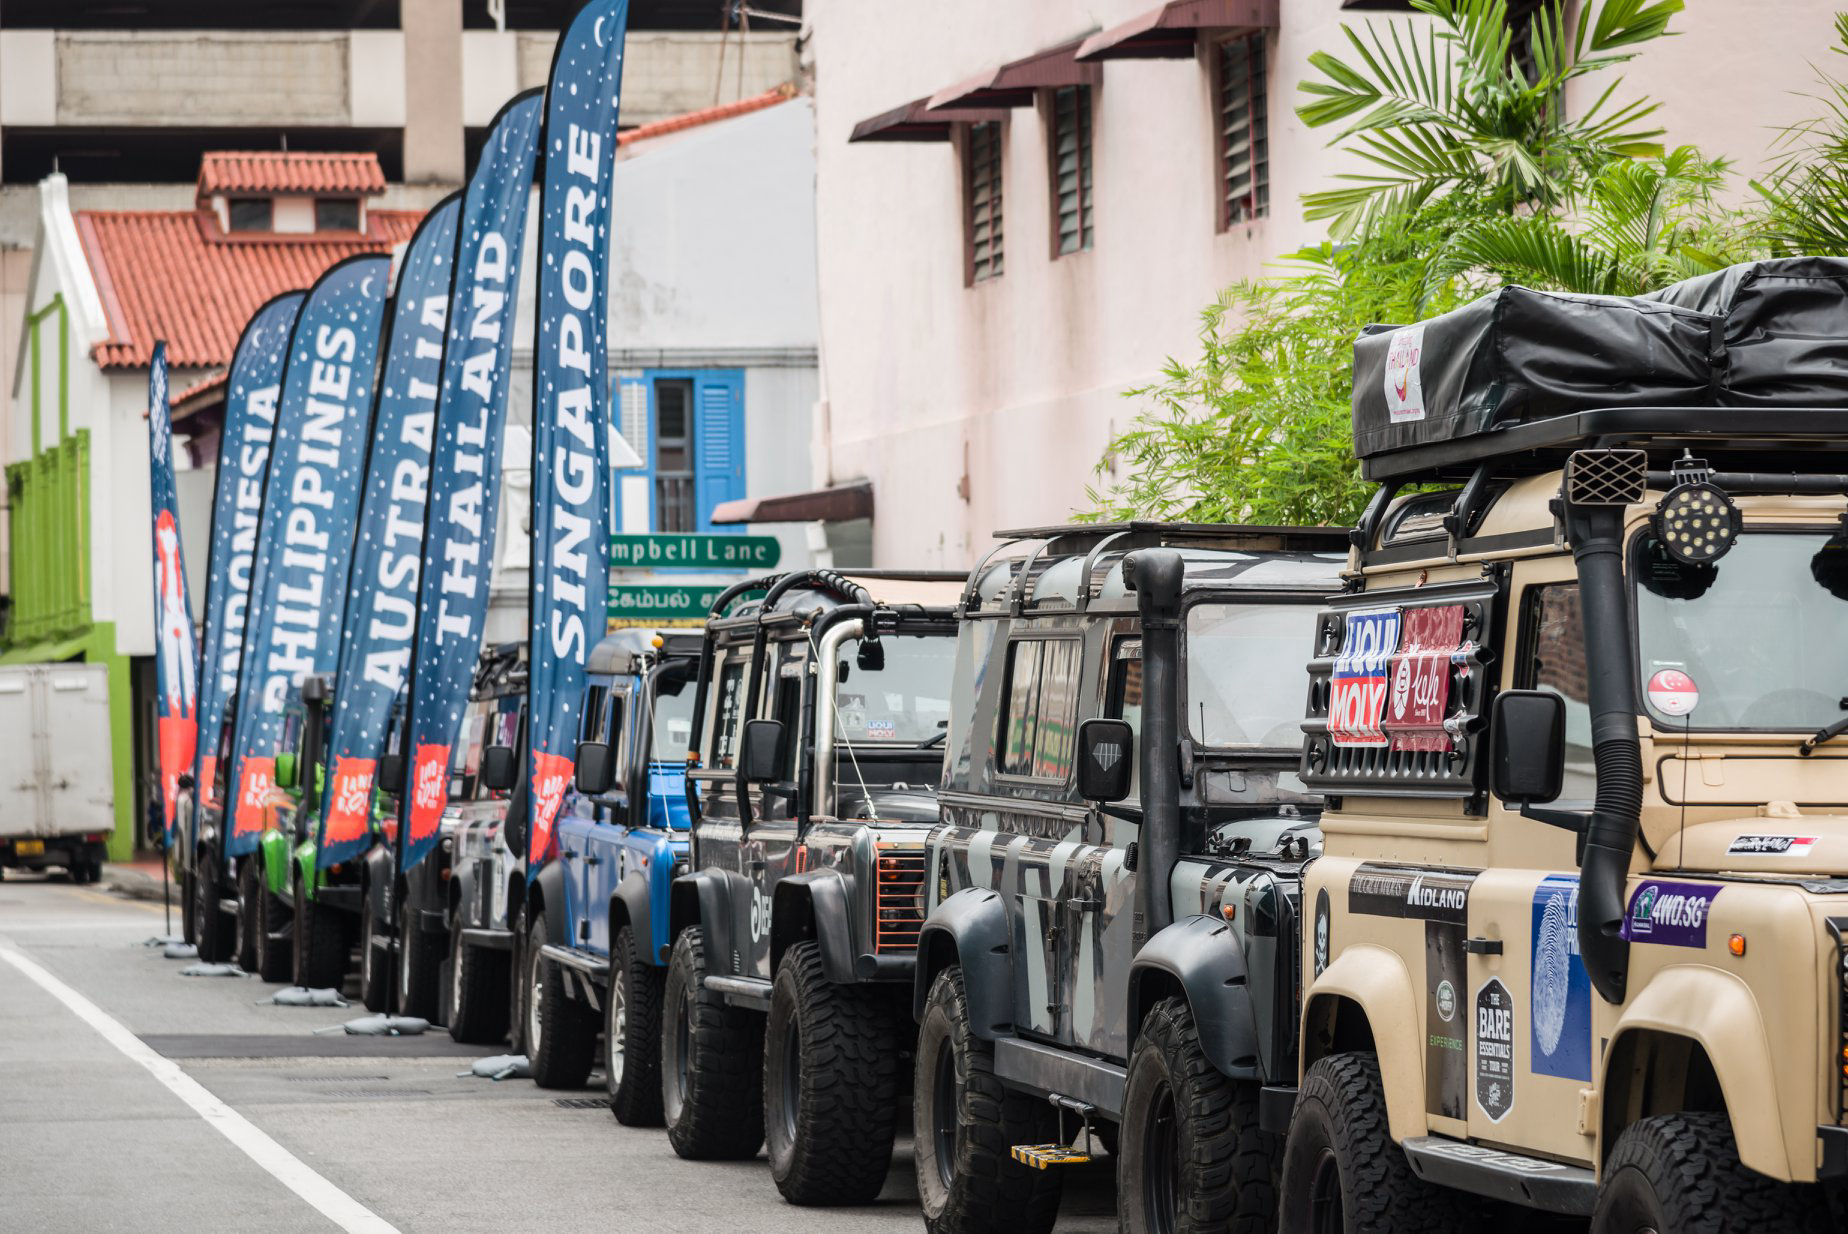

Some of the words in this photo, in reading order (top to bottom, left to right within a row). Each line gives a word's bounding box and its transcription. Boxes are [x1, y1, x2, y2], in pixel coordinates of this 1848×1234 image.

[551, 123, 601, 666] SINGAPORE
[435, 231, 508, 646] THAILAND
[363, 293, 449, 695] AUSTRALIA
[611, 538, 696, 564] mpbell
[707, 539, 767, 561] Lane
[1336, 618, 1397, 676] LIQUI
[1331, 682, 1386, 737] MOLY
[1407, 875, 1466, 910] MIDLAND
[1652, 894, 1707, 928] 4WD.SG
[1479, 1007, 1510, 1041] BARE
[1430, 1035, 1463, 1051] EXPERIENCE
[1479, 1041, 1511, 1059] ESSENTIALS
